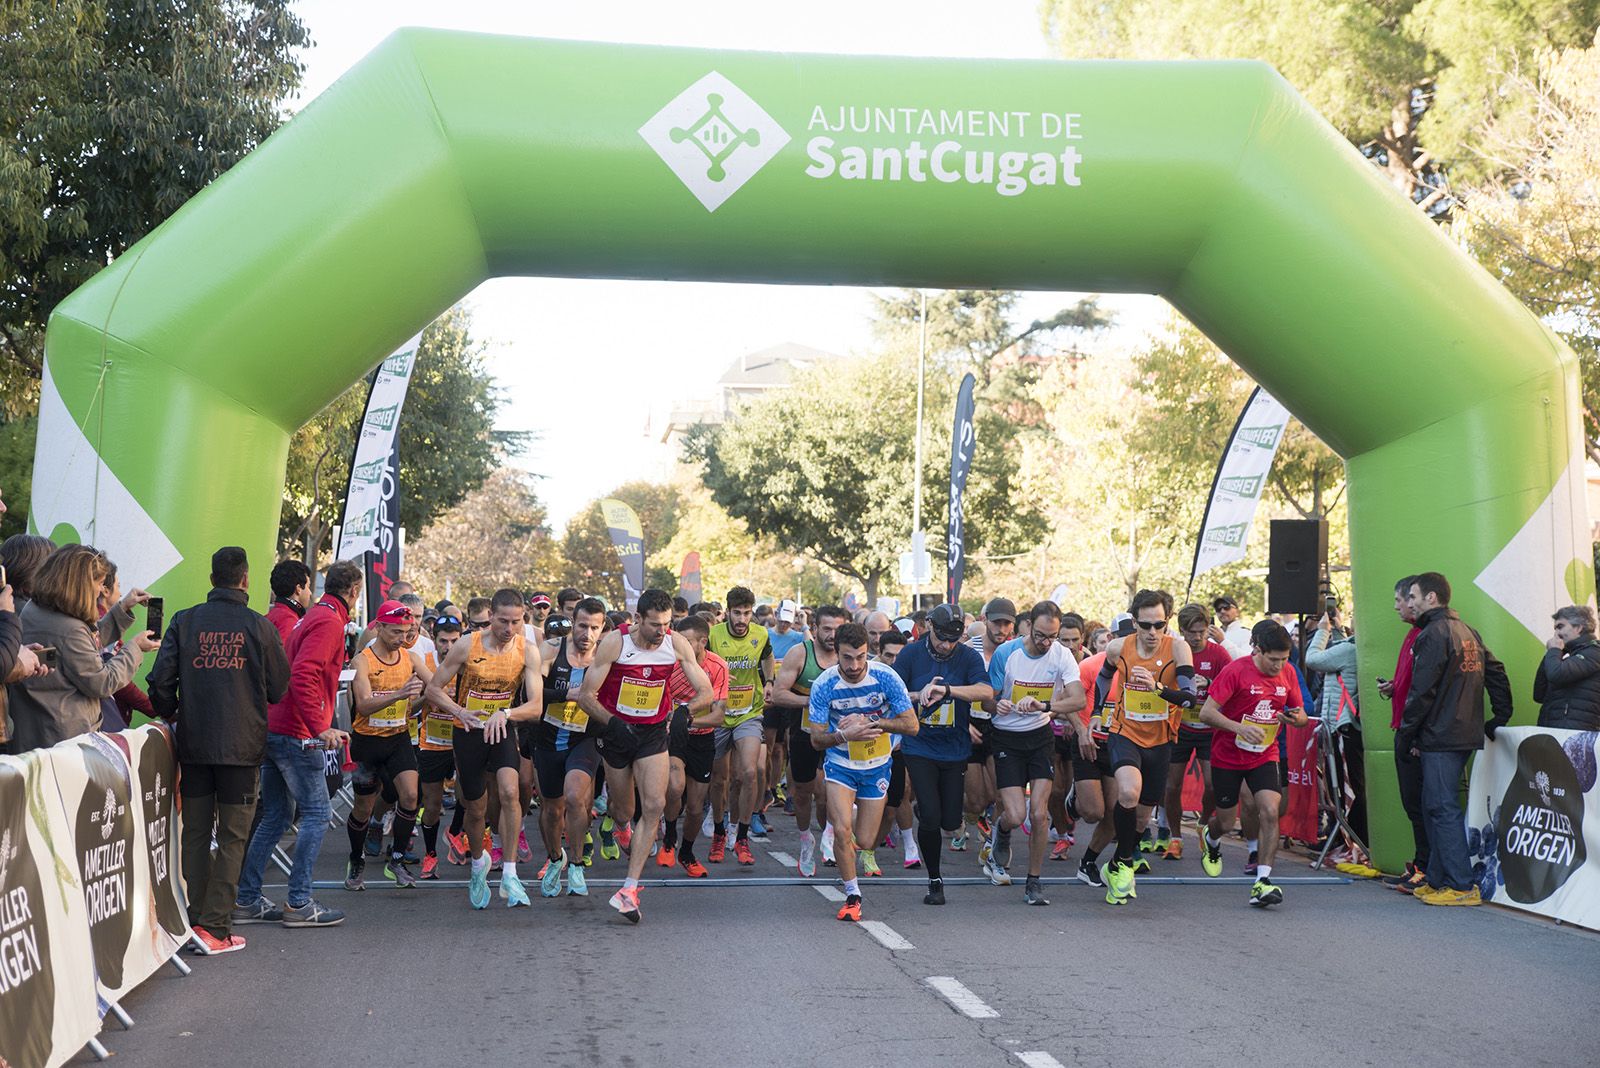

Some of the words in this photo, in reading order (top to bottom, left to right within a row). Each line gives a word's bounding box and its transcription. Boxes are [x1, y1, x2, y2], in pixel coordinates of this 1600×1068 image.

[807, 105, 1031, 138] AJUNTAMENT
[1042, 113, 1083, 140] DE
[805, 136, 1083, 196] SantCugat
[199, 632, 245, 644] MITJA
[200, 644, 243, 656] SANT
[192, 656, 247, 669] CUGAT
[1512, 804, 1575, 837] AMETLLER
[85, 839, 126, 881] AMETLLER
[1506, 825, 1576, 867] ORIGEN
[0, 886, 32, 934] LLER
[85, 871, 127, 927] ORIGEN
[0, 924, 42, 994] IGEN
